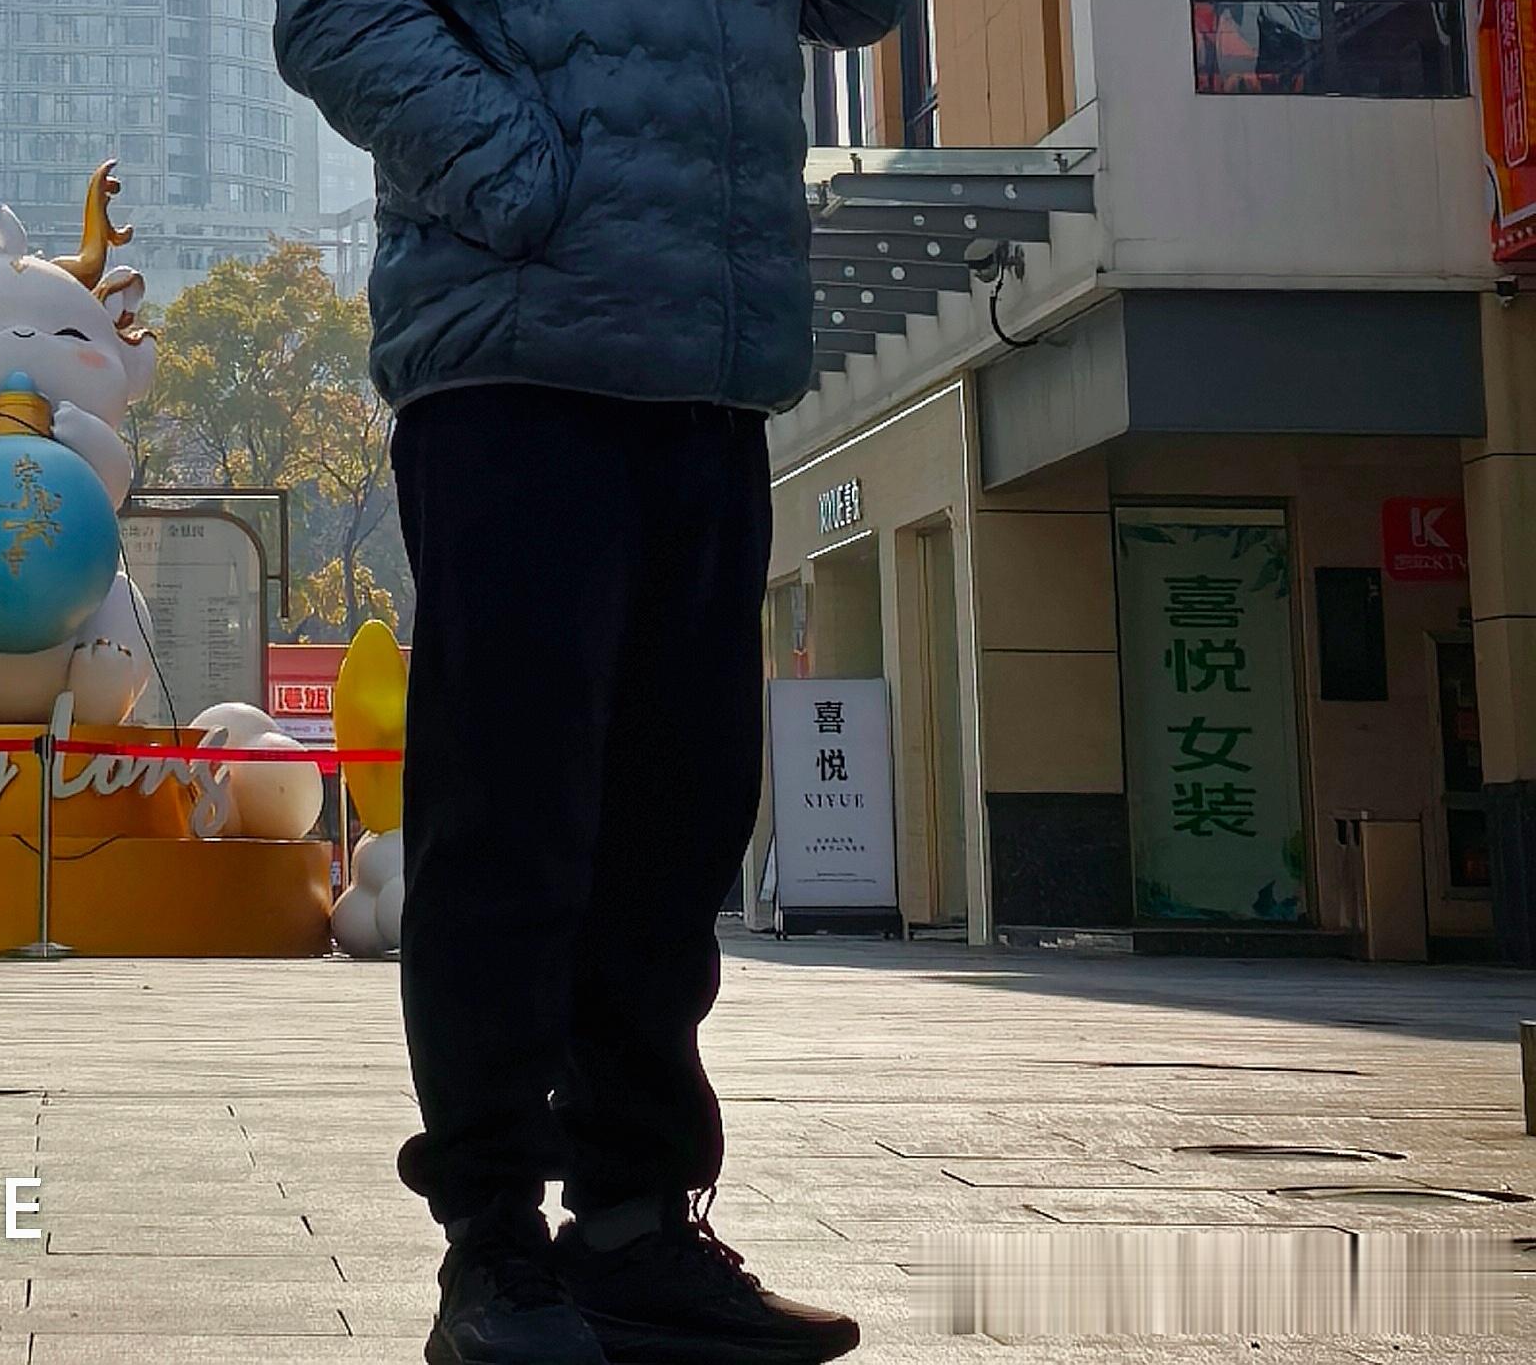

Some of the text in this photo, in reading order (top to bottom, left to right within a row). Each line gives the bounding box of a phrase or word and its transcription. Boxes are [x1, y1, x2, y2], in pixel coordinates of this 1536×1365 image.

[813, 701, 849, 782] 喜悦
[1164, 575, 1258, 838] 喜悦女装
